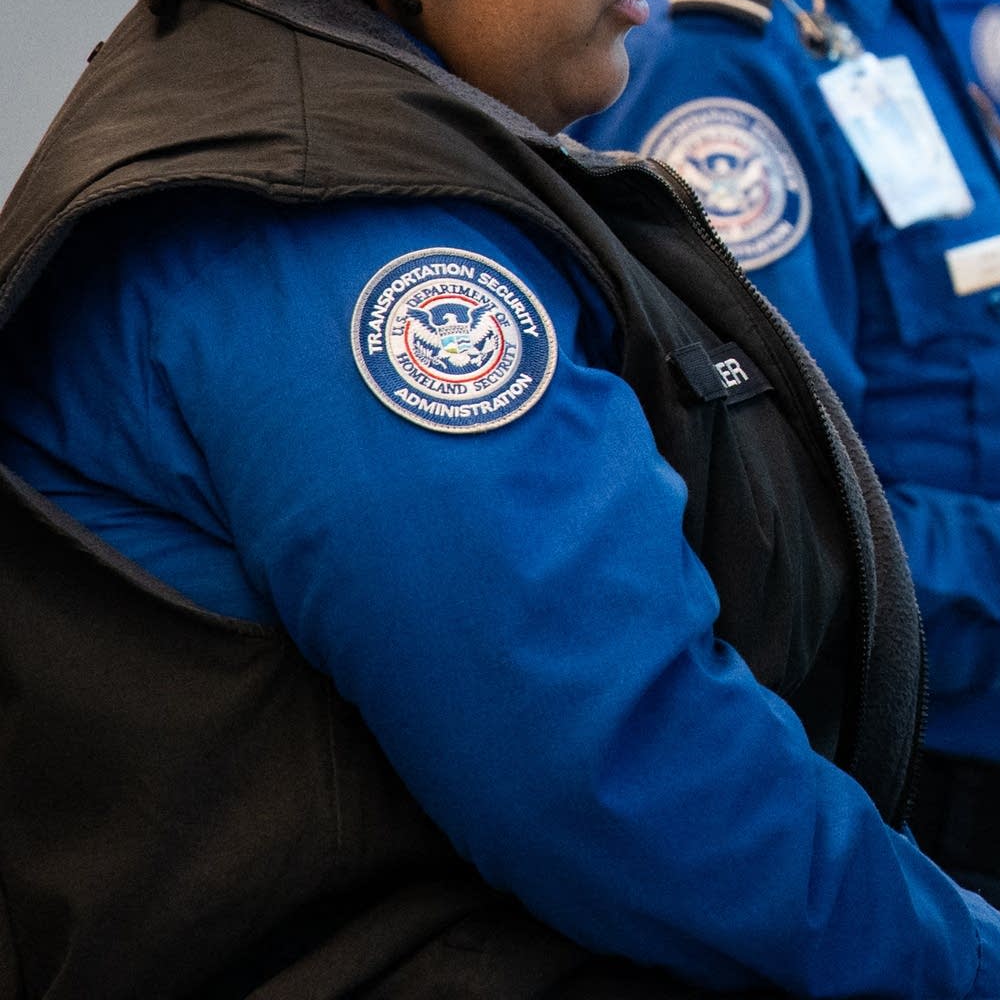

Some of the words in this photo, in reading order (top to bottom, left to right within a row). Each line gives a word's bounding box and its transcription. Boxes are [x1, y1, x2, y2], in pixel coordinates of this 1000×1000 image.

[367, 263, 475, 355] TRANSPORTATION
[478, 272, 539, 338] SECURITY
[405, 284, 497, 313] DEPARTMENT
[495, 312, 511, 328] OF
[396, 352, 468, 395] HOMELAND
[473, 341, 517, 392] SECURITY
[714, 358, 749, 388] ER
[394, 373, 533, 418] ADMINISTRATION
